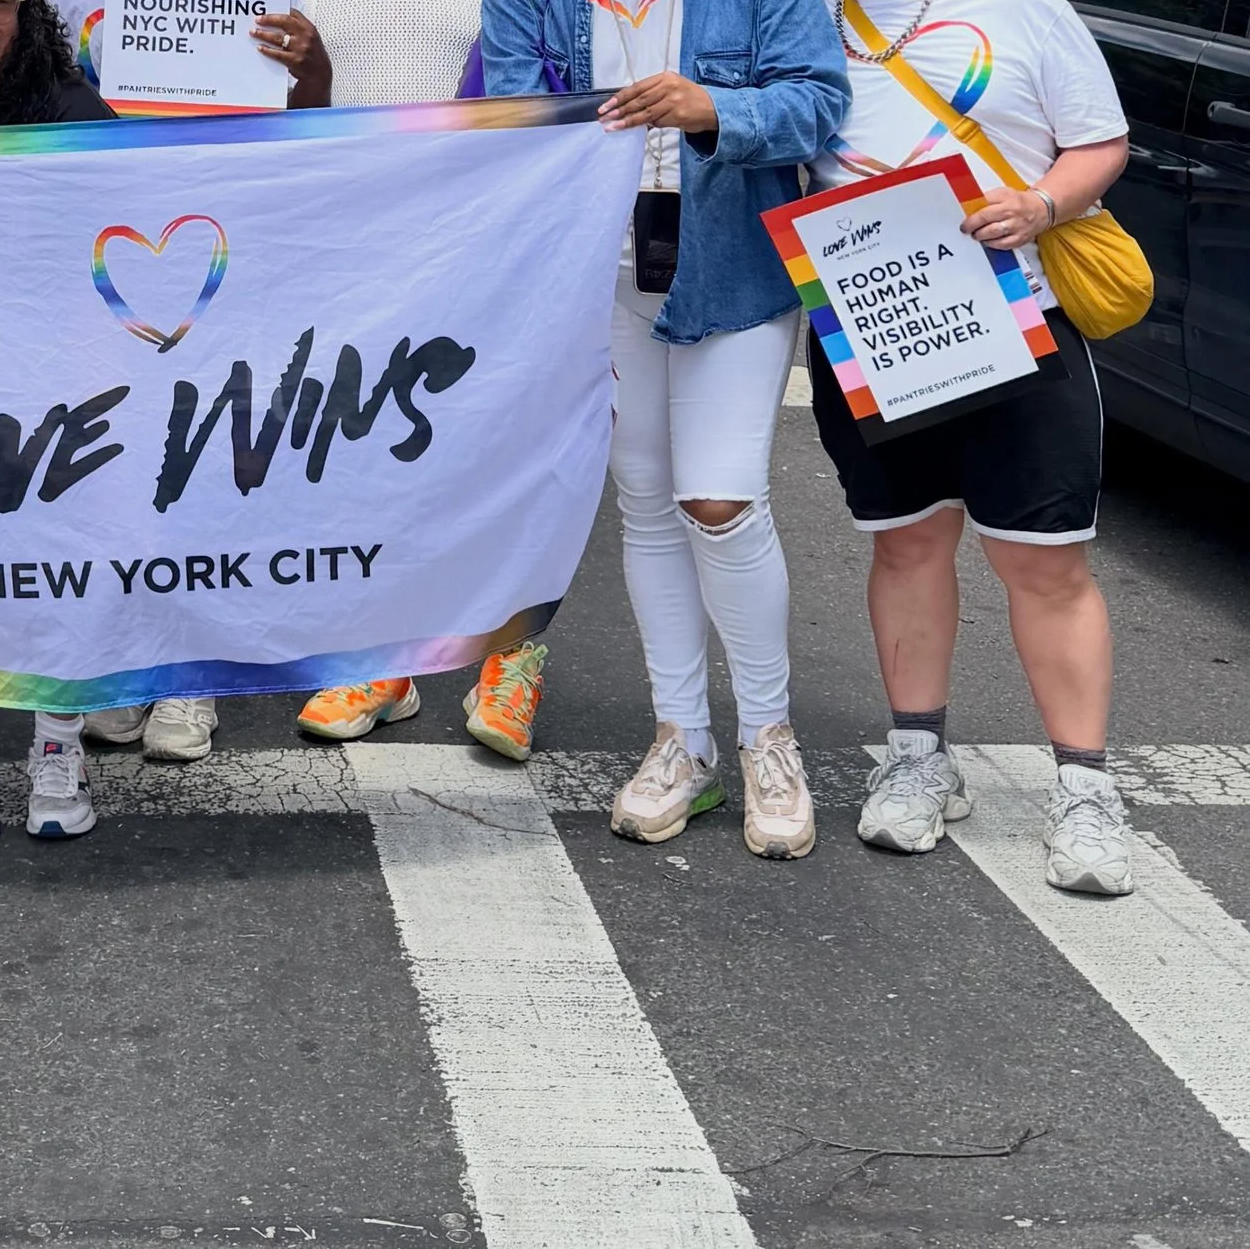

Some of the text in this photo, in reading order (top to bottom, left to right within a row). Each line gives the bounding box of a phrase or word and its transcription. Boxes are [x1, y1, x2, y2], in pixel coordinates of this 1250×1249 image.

[121, 35, 194, 53] PRIDE.
[123, 14, 236, 36] NYC WITH
[118, 85, 217, 97] #PANTRIESWITHPRIDE
[823, 236, 848, 257] LOVE
[837, 243, 954, 294] FOOD IS A
[846, 273, 930, 314] HUMAN
[854, 297, 929, 333] RIGHT.
[863, 300, 975, 351] VISIBILITY
[871, 321, 991, 371] IS POWER.
[887, 364, 996, 406] #PANTRIESWITHPRIDE
[153, 326, 476, 513] WINS
[109, 554, 252, 594] YORK
[269, 543, 384, 584] CITY
